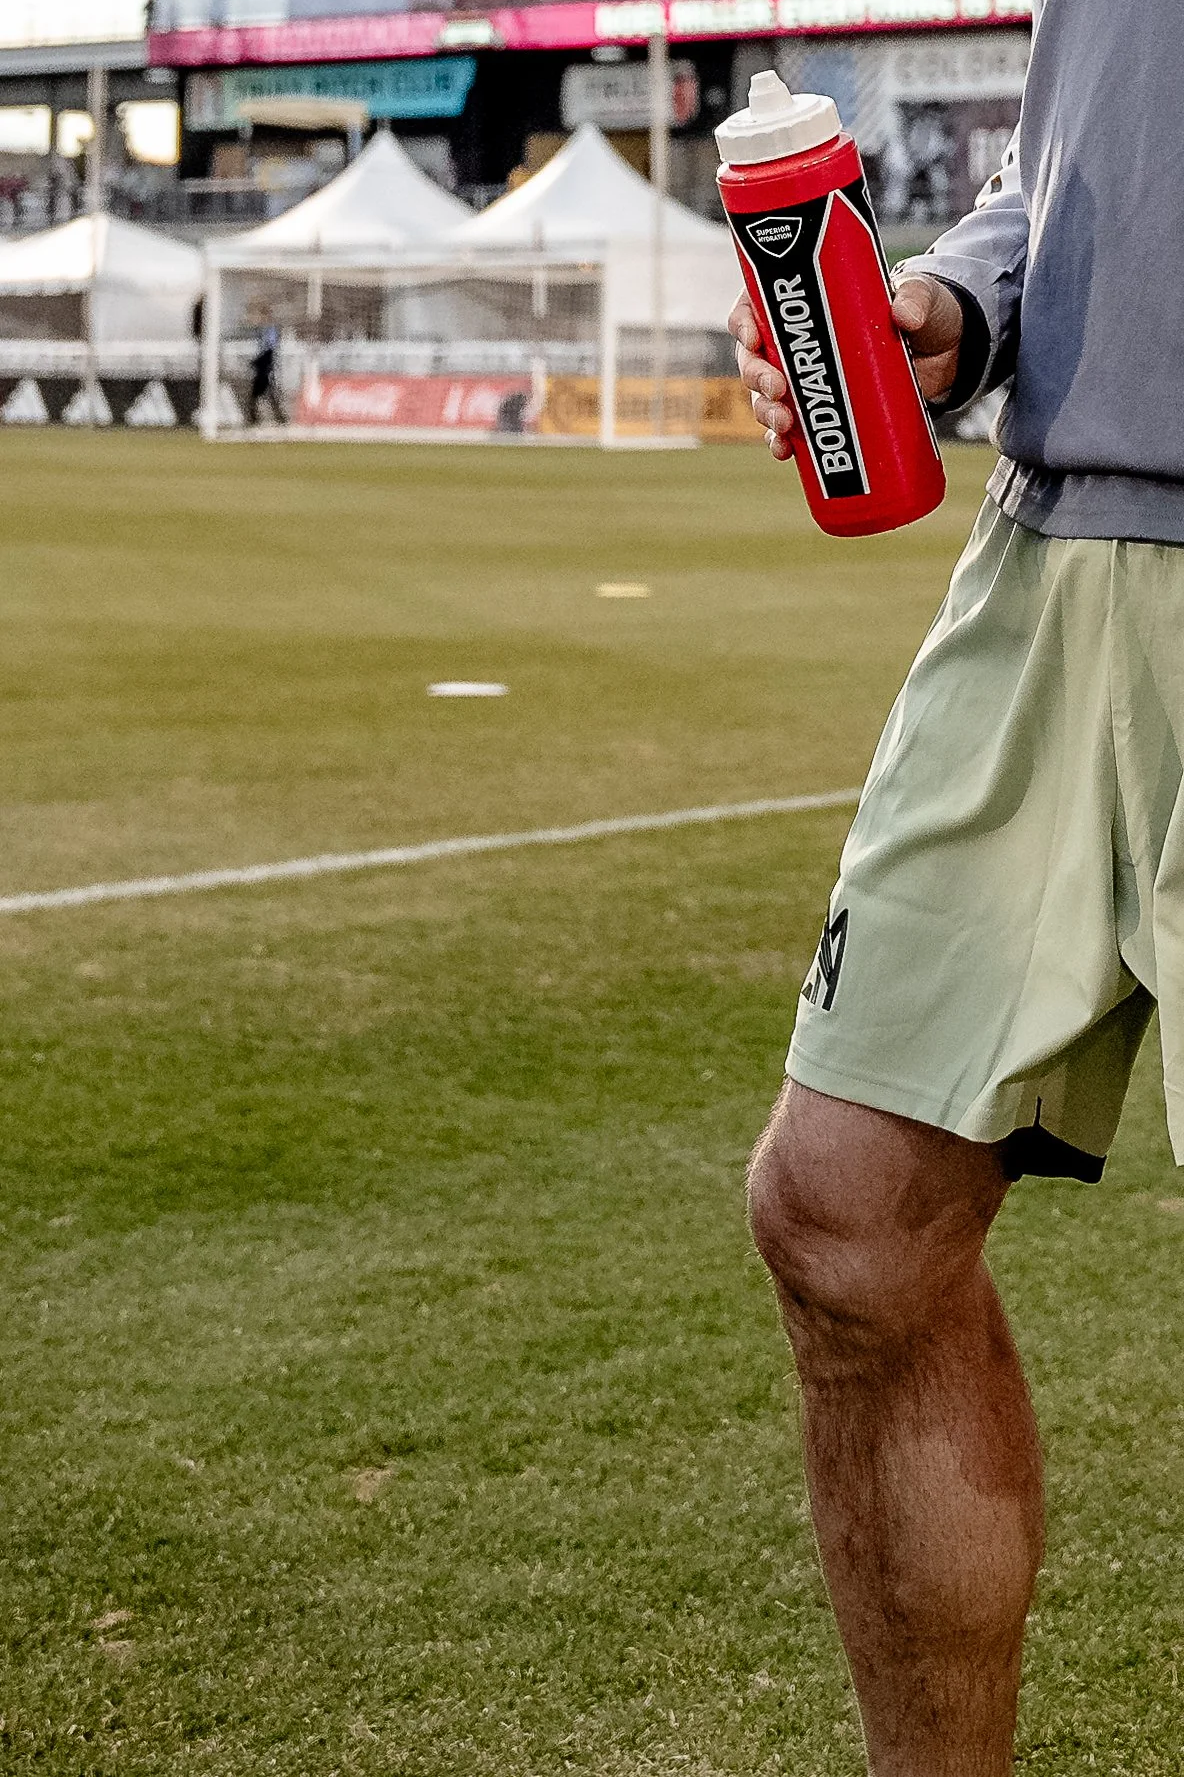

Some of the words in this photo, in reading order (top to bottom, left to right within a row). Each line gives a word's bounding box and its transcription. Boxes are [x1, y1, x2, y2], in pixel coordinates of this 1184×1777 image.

[755, 225, 790, 236] SUPERIOR
[758, 232, 792, 242] HYDRATION
[774, 275, 853, 474] BODYARMOR
